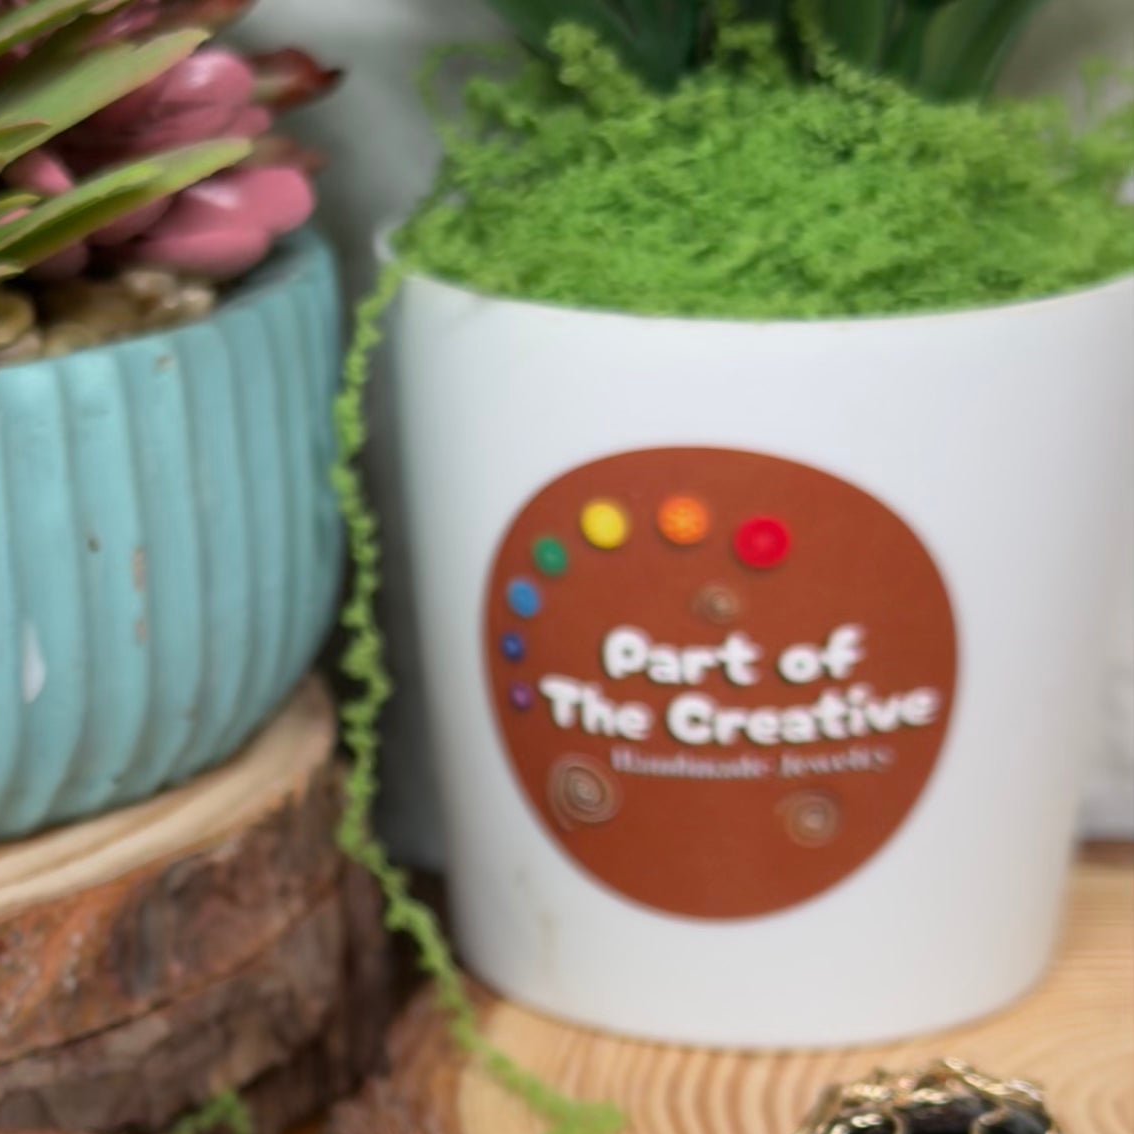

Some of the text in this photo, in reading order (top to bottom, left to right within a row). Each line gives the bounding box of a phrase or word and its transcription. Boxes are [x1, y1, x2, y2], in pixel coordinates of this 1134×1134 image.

[602, 622, 865, 686] Part of
[537, 674, 942, 745] The Creative
